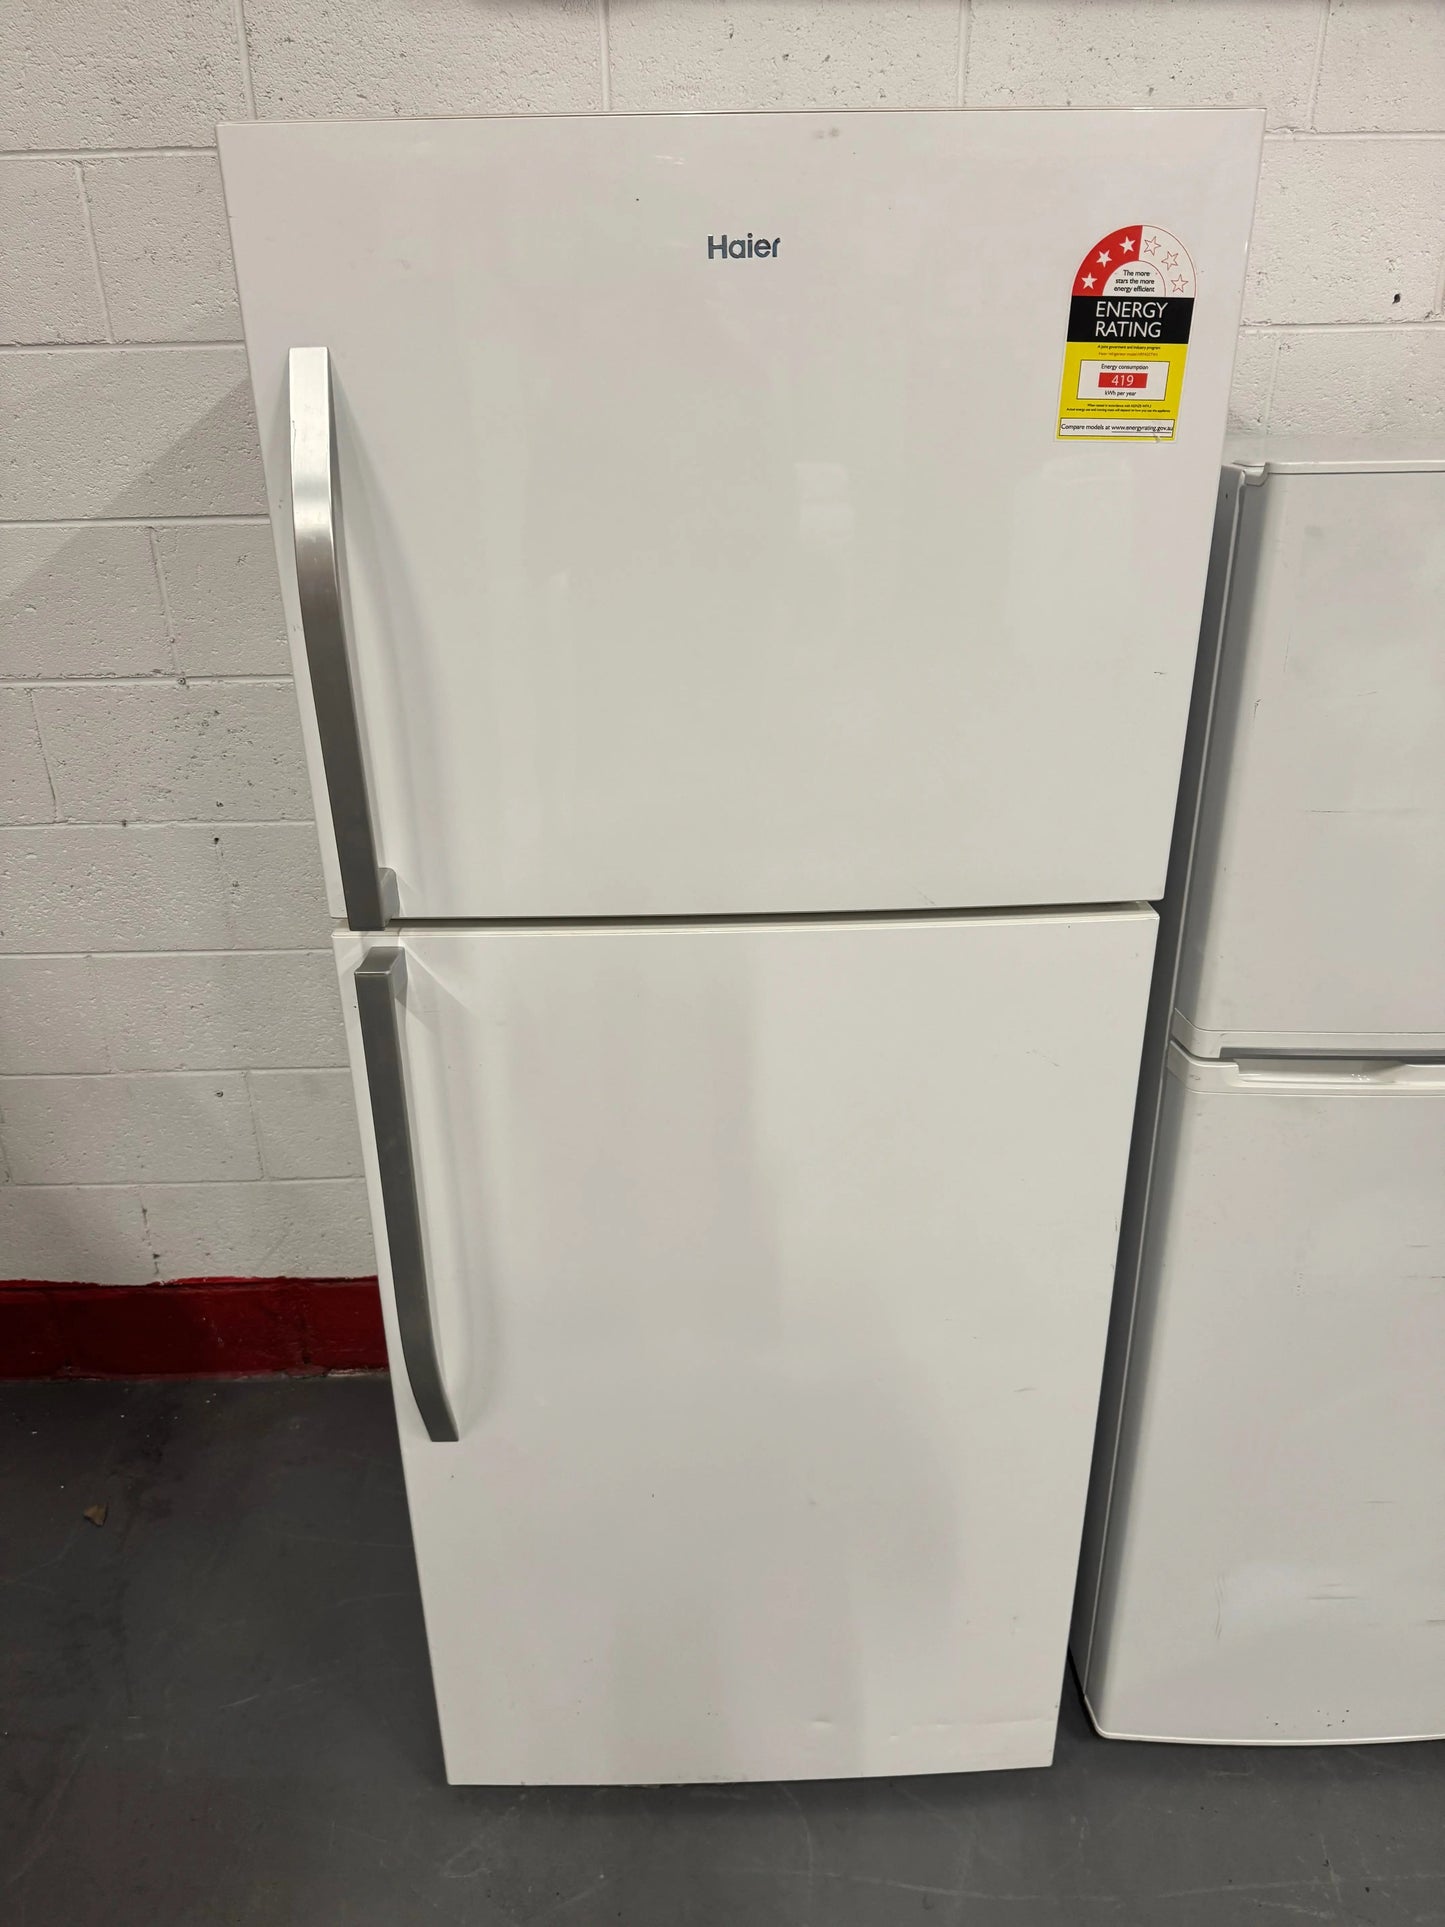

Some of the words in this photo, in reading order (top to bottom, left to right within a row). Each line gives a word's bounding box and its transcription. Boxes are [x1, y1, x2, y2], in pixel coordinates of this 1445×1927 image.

[707, 232, 781, 260] Haier
[1095, 300, 1169, 318] ENERGY
[1095, 320, 1162, 338] RATING
[1111, 374, 1134, 387] 419
